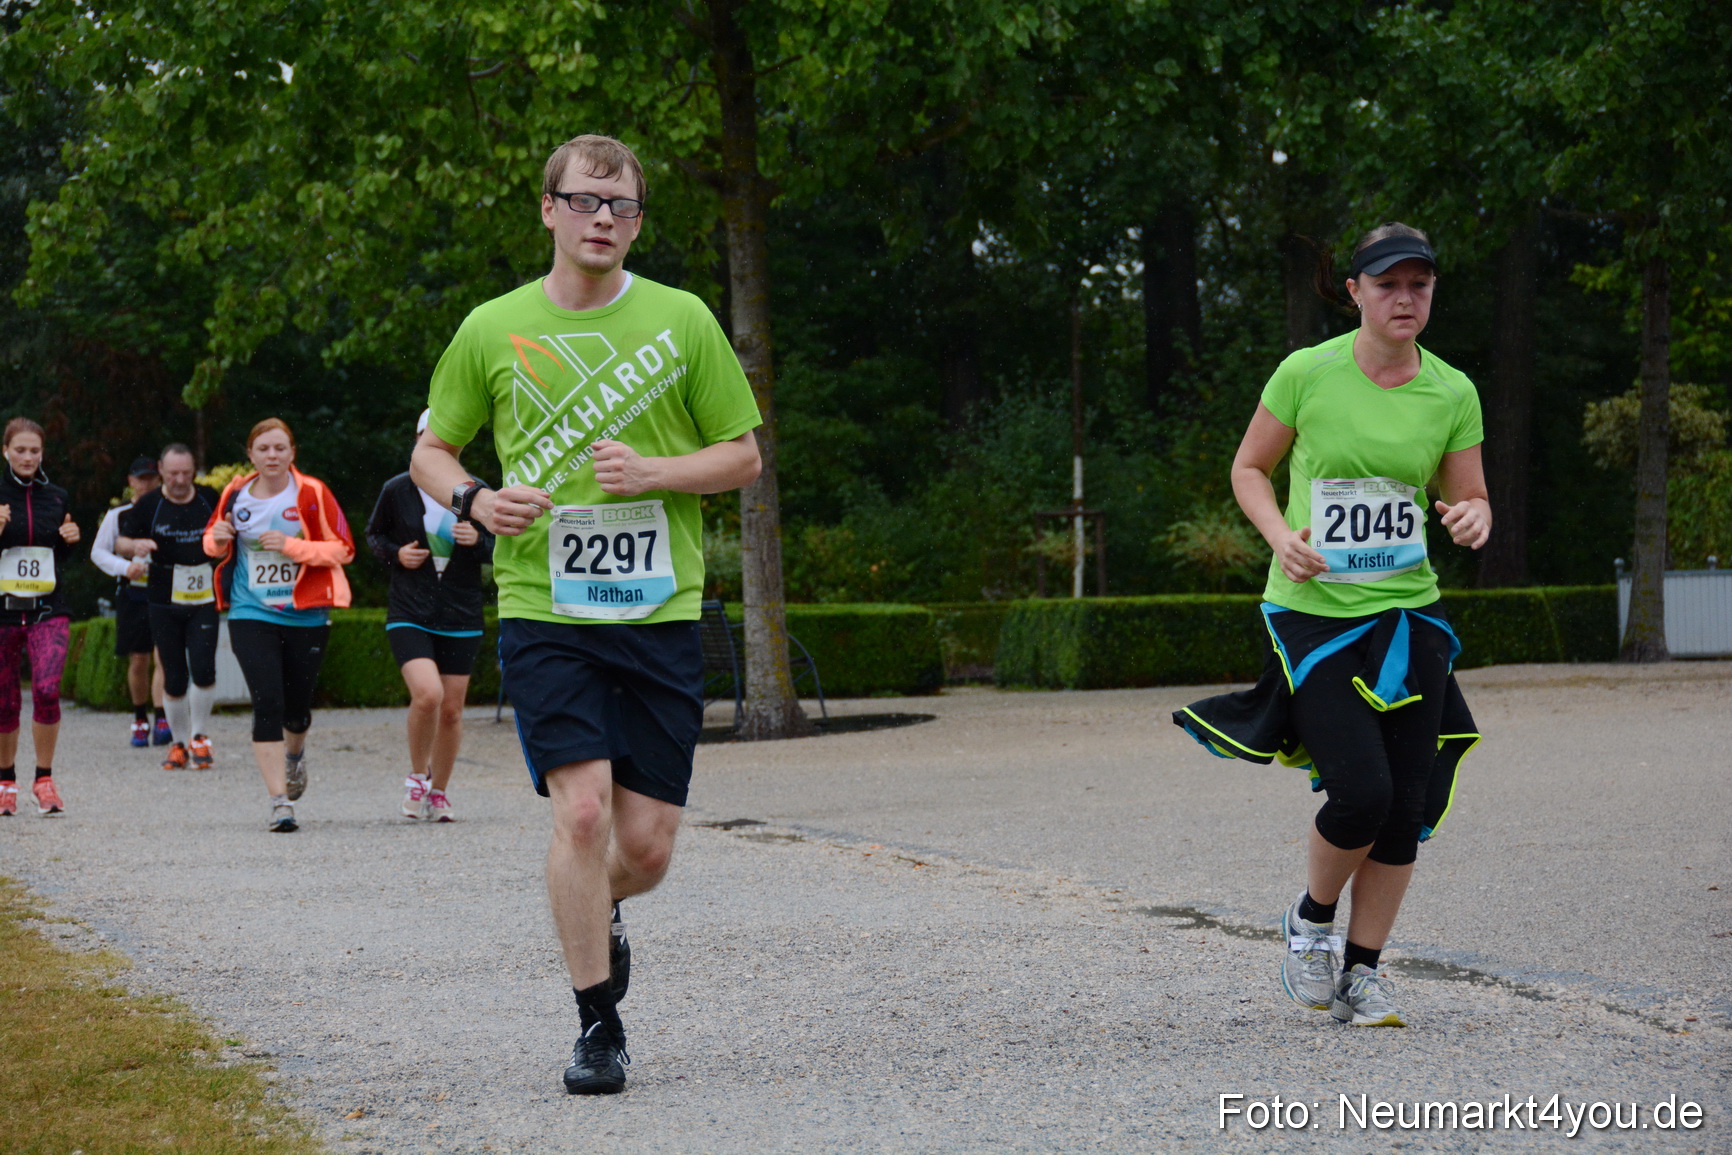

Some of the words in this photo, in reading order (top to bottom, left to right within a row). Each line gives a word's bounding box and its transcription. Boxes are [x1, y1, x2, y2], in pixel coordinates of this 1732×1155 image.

[1363, 480, 1407, 494] BOCK
[559, 517, 595, 526] NeuerMarkt
[602, 504, 656, 522] BOCK
[1324, 501, 1415, 543] 2045
[562, 530, 657, 575] 2297
[1348, 552, 1395, 569] Kristin
[17, 559, 40, 578] 68
[187, 575, 204, 590] 28
[587, 586, 644, 603] Nathan
